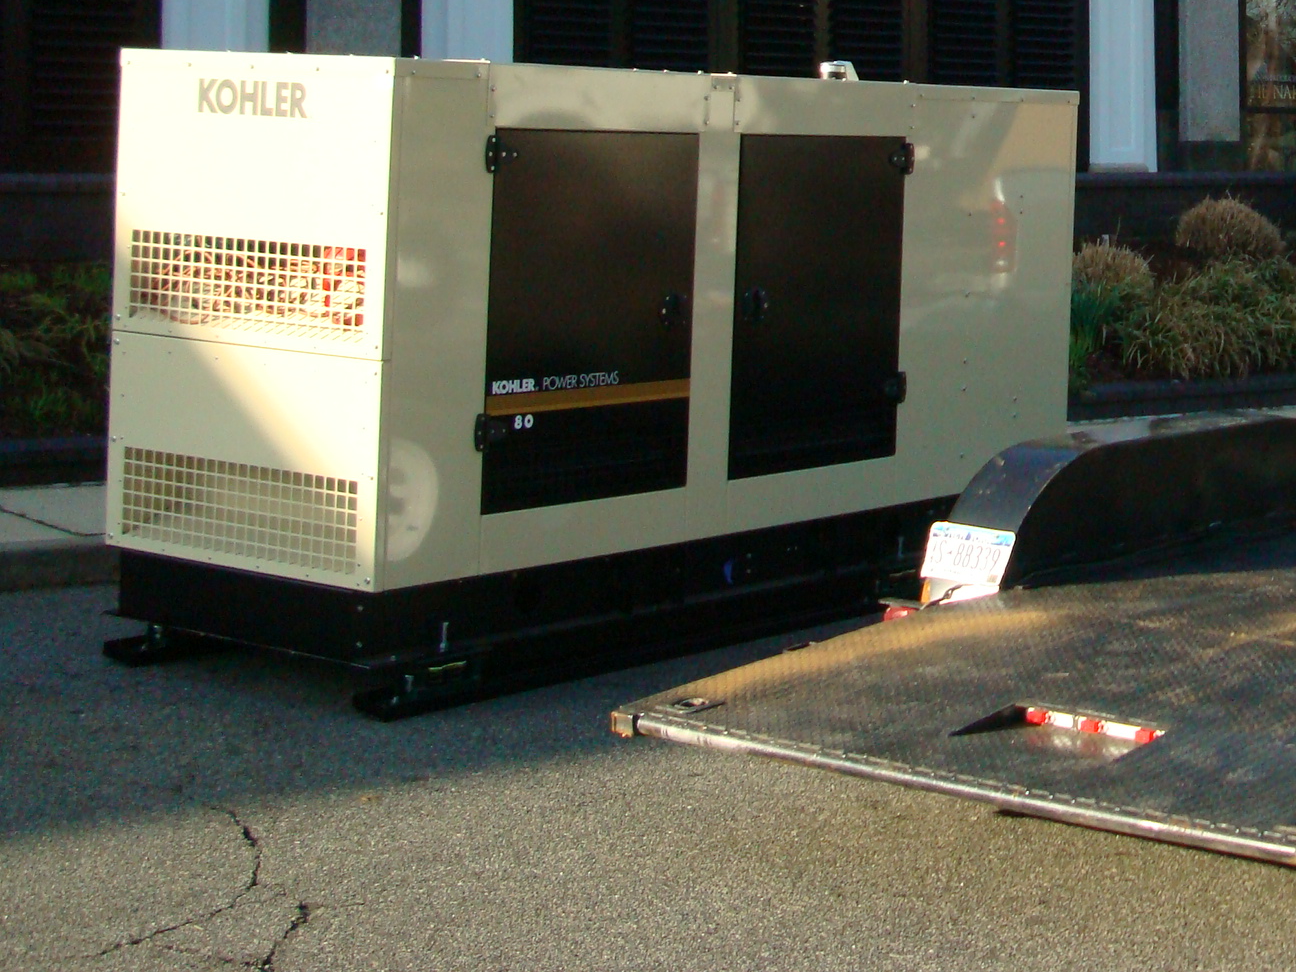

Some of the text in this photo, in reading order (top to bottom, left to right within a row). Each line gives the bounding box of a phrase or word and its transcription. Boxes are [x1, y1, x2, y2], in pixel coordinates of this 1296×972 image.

[198, 78, 308, 119] KOHLER
[491, 371, 620, 395] KOHLER POWER SYSTEMS
[513, 414, 534, 429] 80
